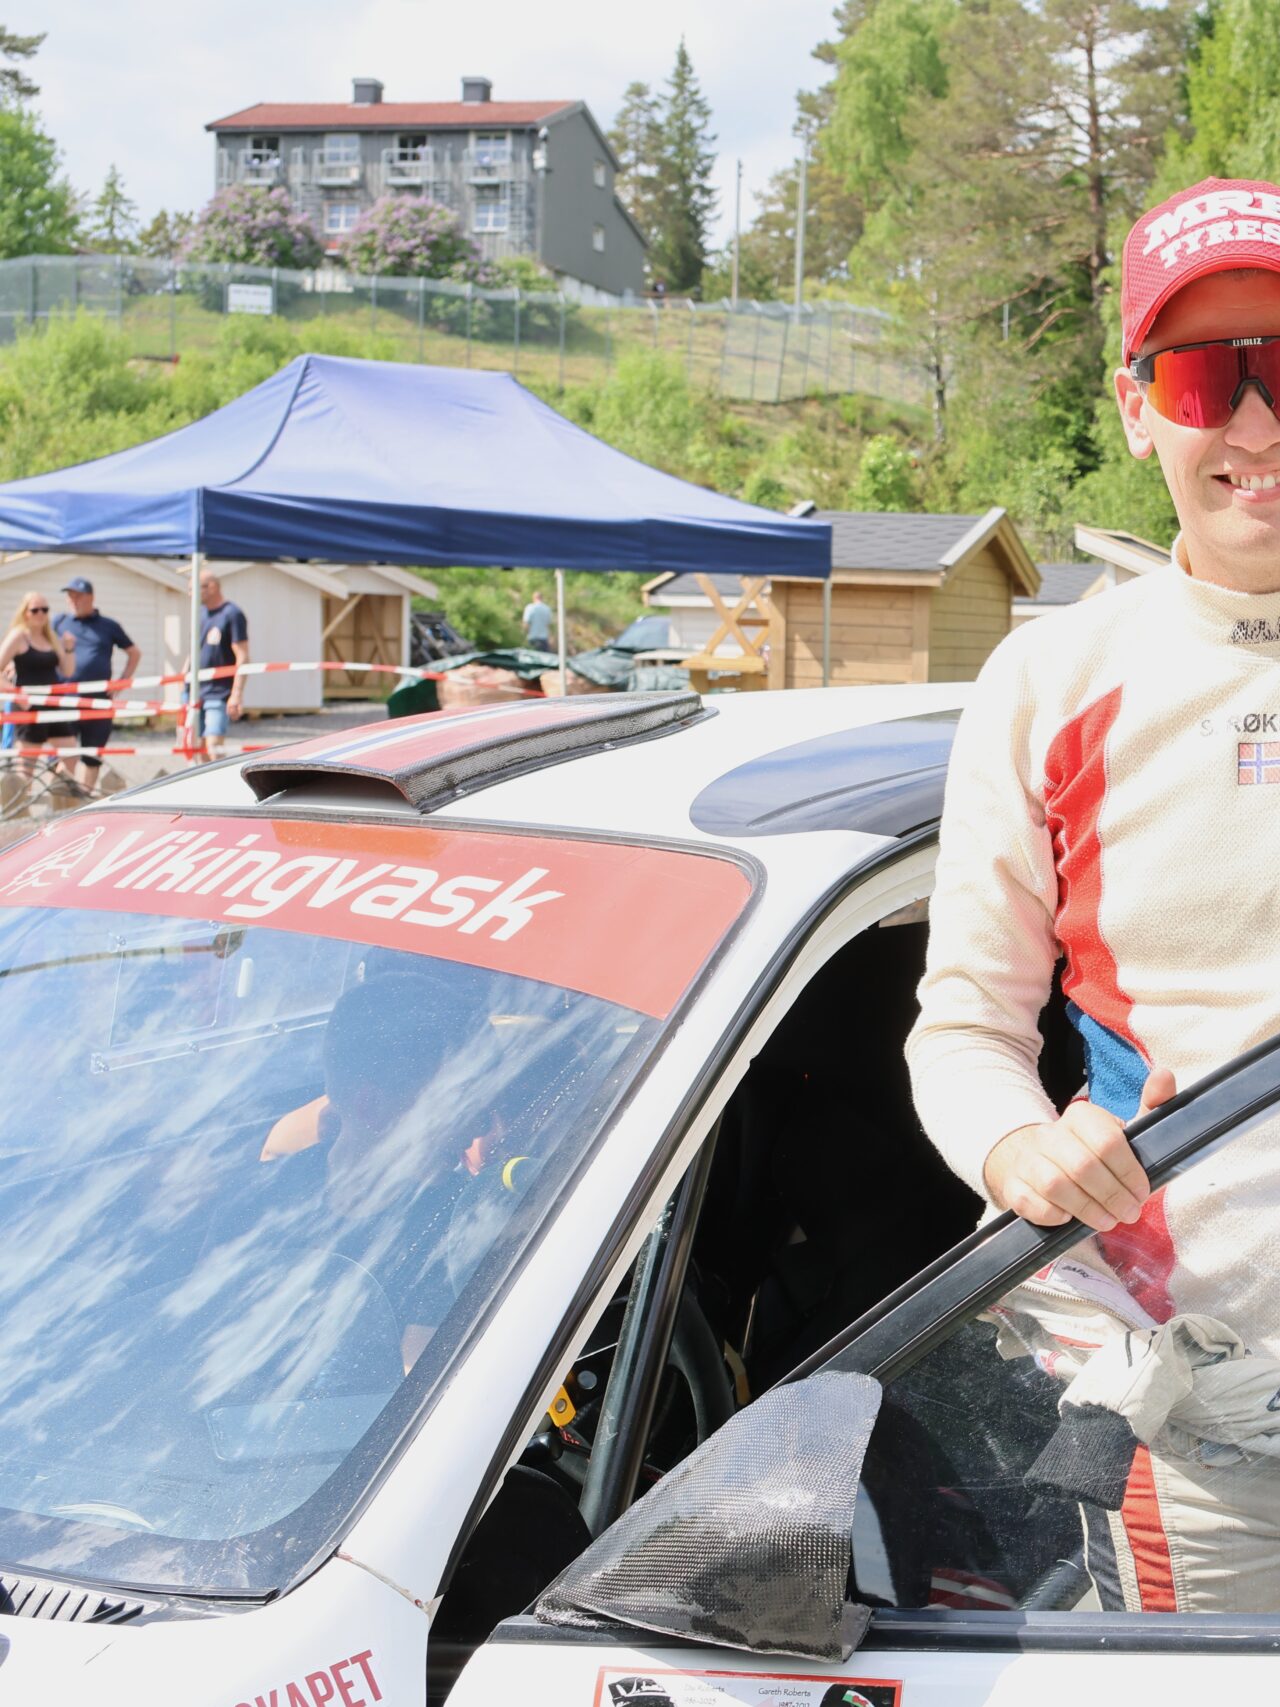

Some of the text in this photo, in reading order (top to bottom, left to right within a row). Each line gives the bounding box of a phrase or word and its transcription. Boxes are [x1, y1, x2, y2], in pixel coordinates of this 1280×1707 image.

[78, 829, 566, 942] Vikingvask
[757, 1687, 812, 1698] Gareth Roberts
